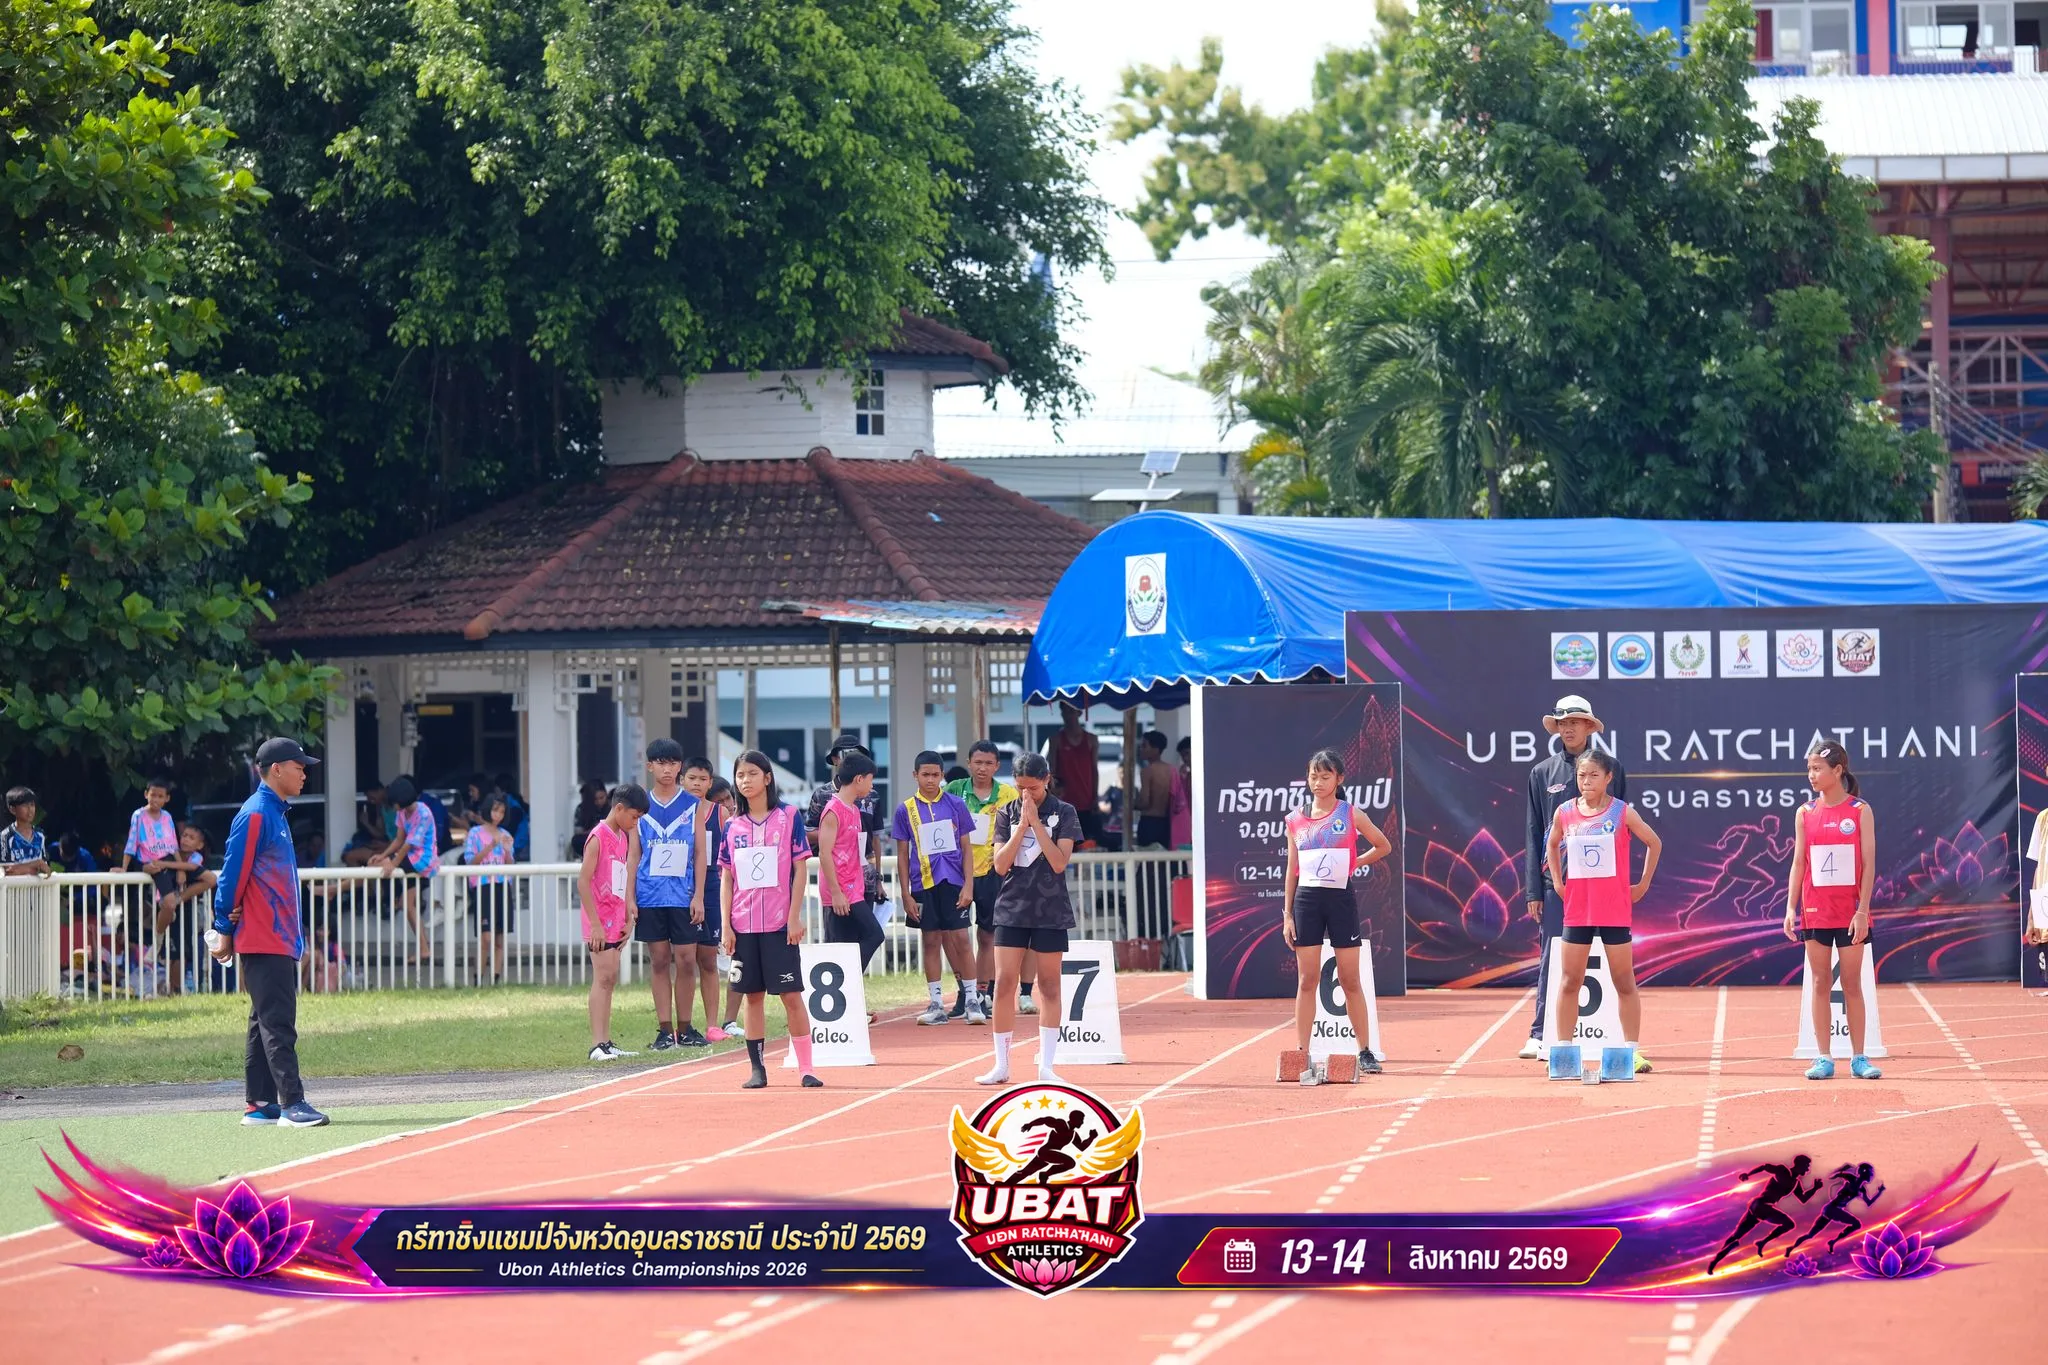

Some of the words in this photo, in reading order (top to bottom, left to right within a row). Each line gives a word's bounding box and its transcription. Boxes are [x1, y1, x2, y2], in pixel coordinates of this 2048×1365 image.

[1645, 725, 1977, 762] RATCHATHANI
[1218, 778, 1392, 813] กรีฑาชิงชมป์
[1628, 788, 1813, 818] .อุบลราชธา
[933, 828, 945, 848] 6
[659, 849, 673, 869] 2
[751, 852, 765, 881] 8
[1315, 854, 1332, 878] 6
[1583, 845, 1601, 868] 5
[1821, 851, 1839, 878] 4
[808, 961, 847, 1022] 8
[1061, 960, 1100, 1021] 7
[1319, 955, 1348, 1017] 6
[1573, 1022, 1604, 1039] elco
